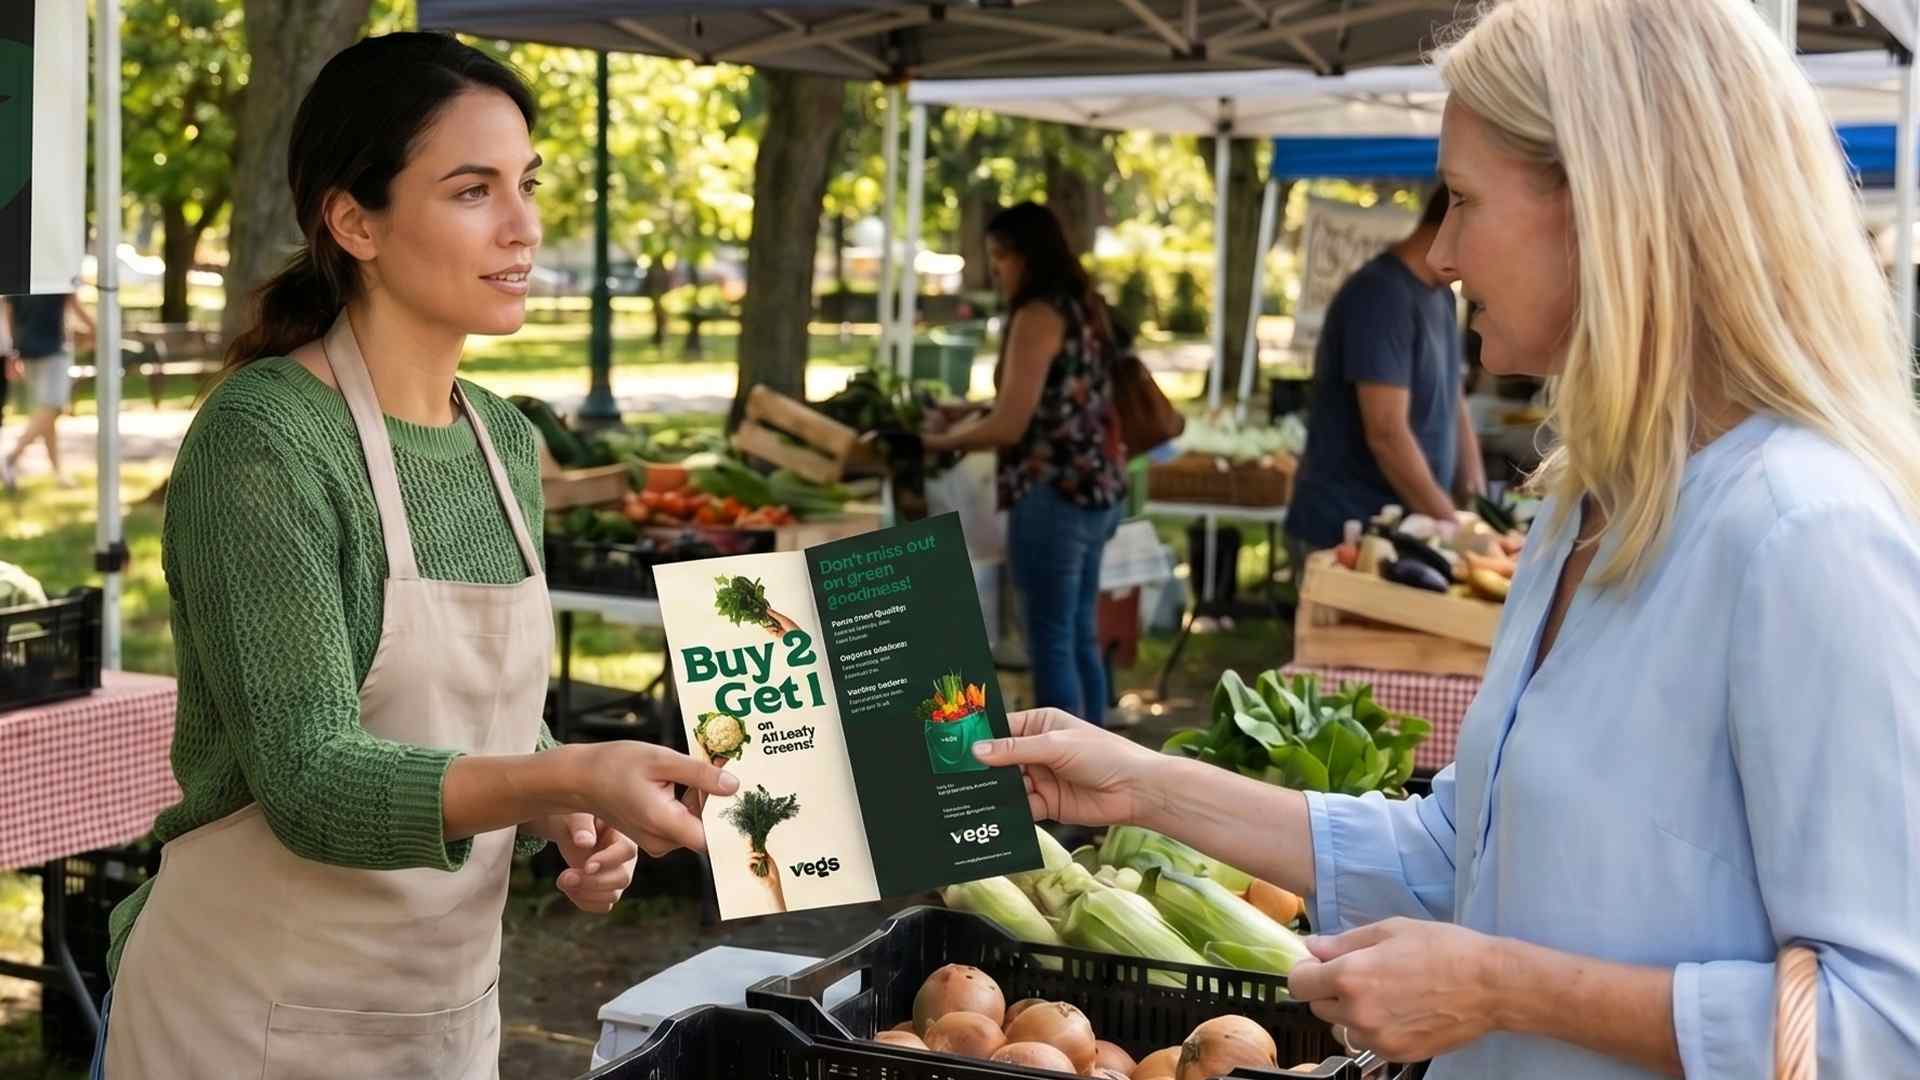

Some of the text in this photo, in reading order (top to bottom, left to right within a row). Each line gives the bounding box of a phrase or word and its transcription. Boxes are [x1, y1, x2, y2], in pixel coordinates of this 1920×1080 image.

[819, 535, 936, 575] Don't miss out
[823, 564, 895, 590] on green
[681, 629, 817, 684] Buy 2
[715, 675, 803, 718] Get
[806, 671, 826, 707] 1
[757, 721, 774, 731] on
[761, 730, 779, 744] All
[763, 737, 815, 755] Greens!
[950, 823, 1000, 844] vegs
[789, 856, 840, 878] vegs
